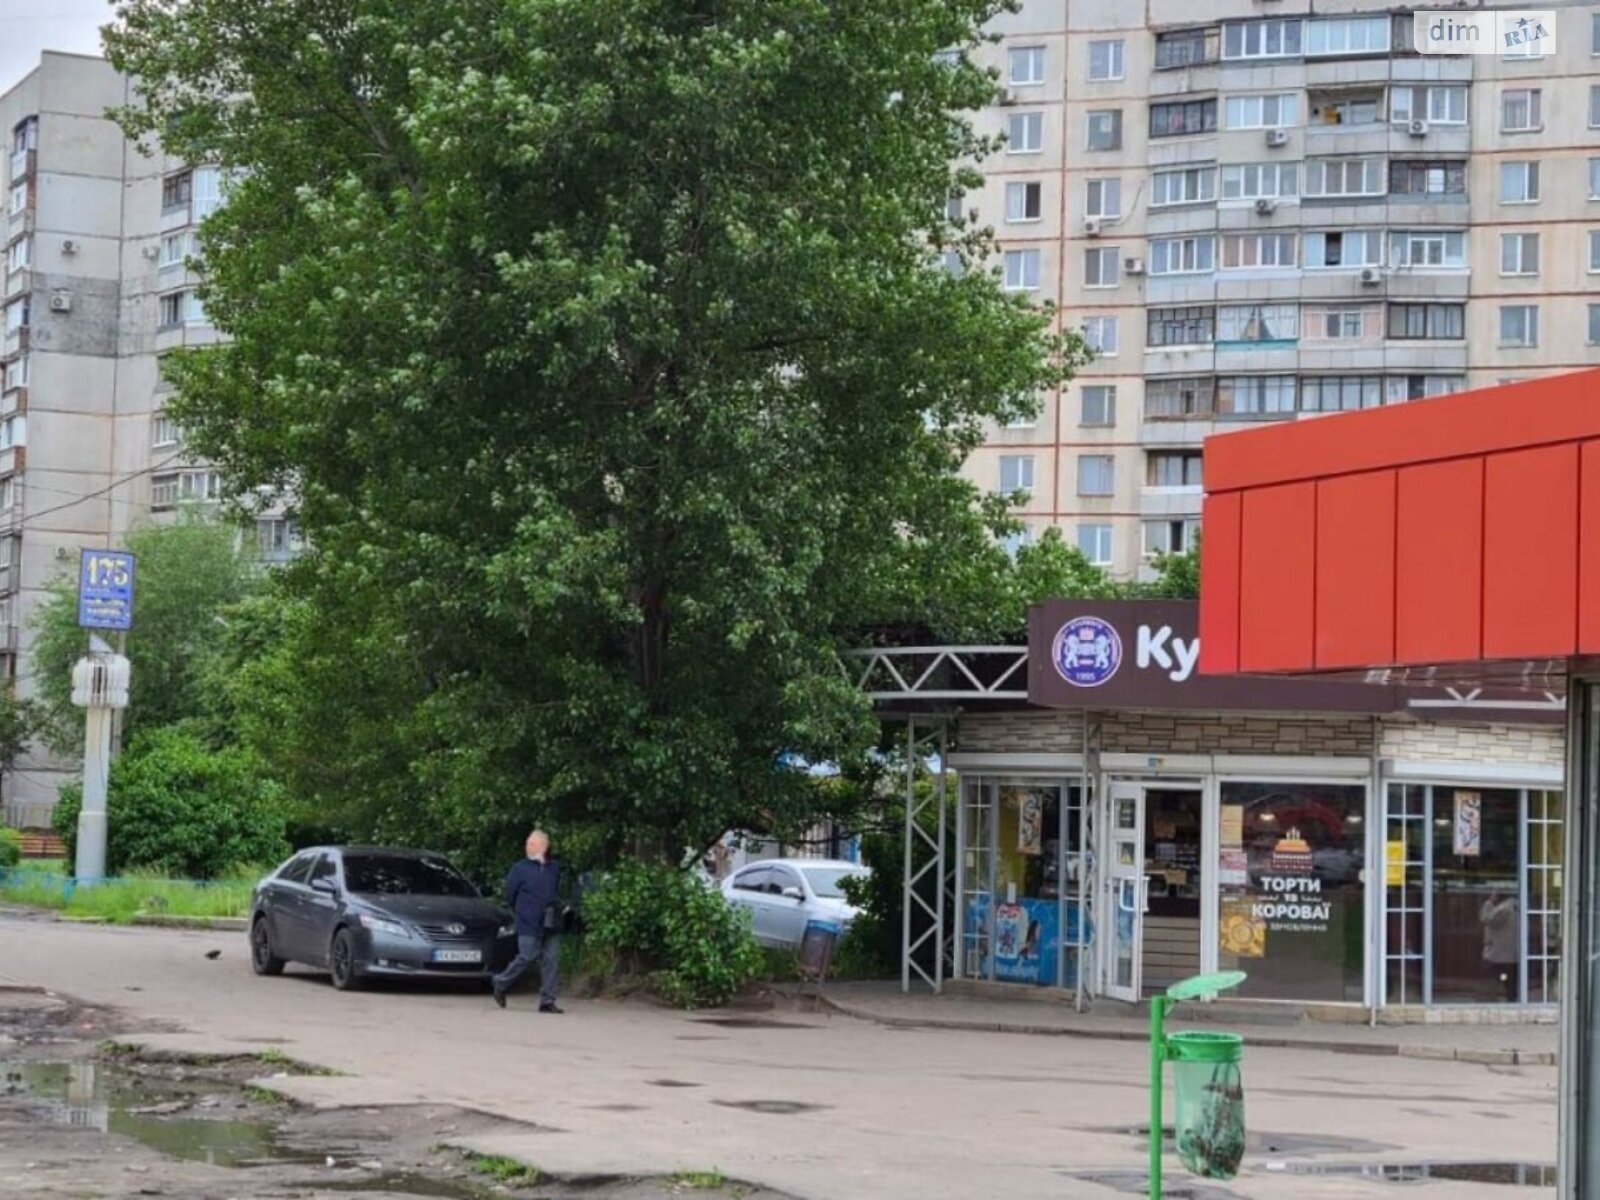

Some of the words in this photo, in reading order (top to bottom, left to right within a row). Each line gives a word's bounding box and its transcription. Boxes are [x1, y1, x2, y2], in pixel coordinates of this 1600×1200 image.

[87, 556, 129, 586] 175
[1260, 876, 1321, 893] ТОРТИ
[1252, 902, 1331, 920] КОРОВАЇ
